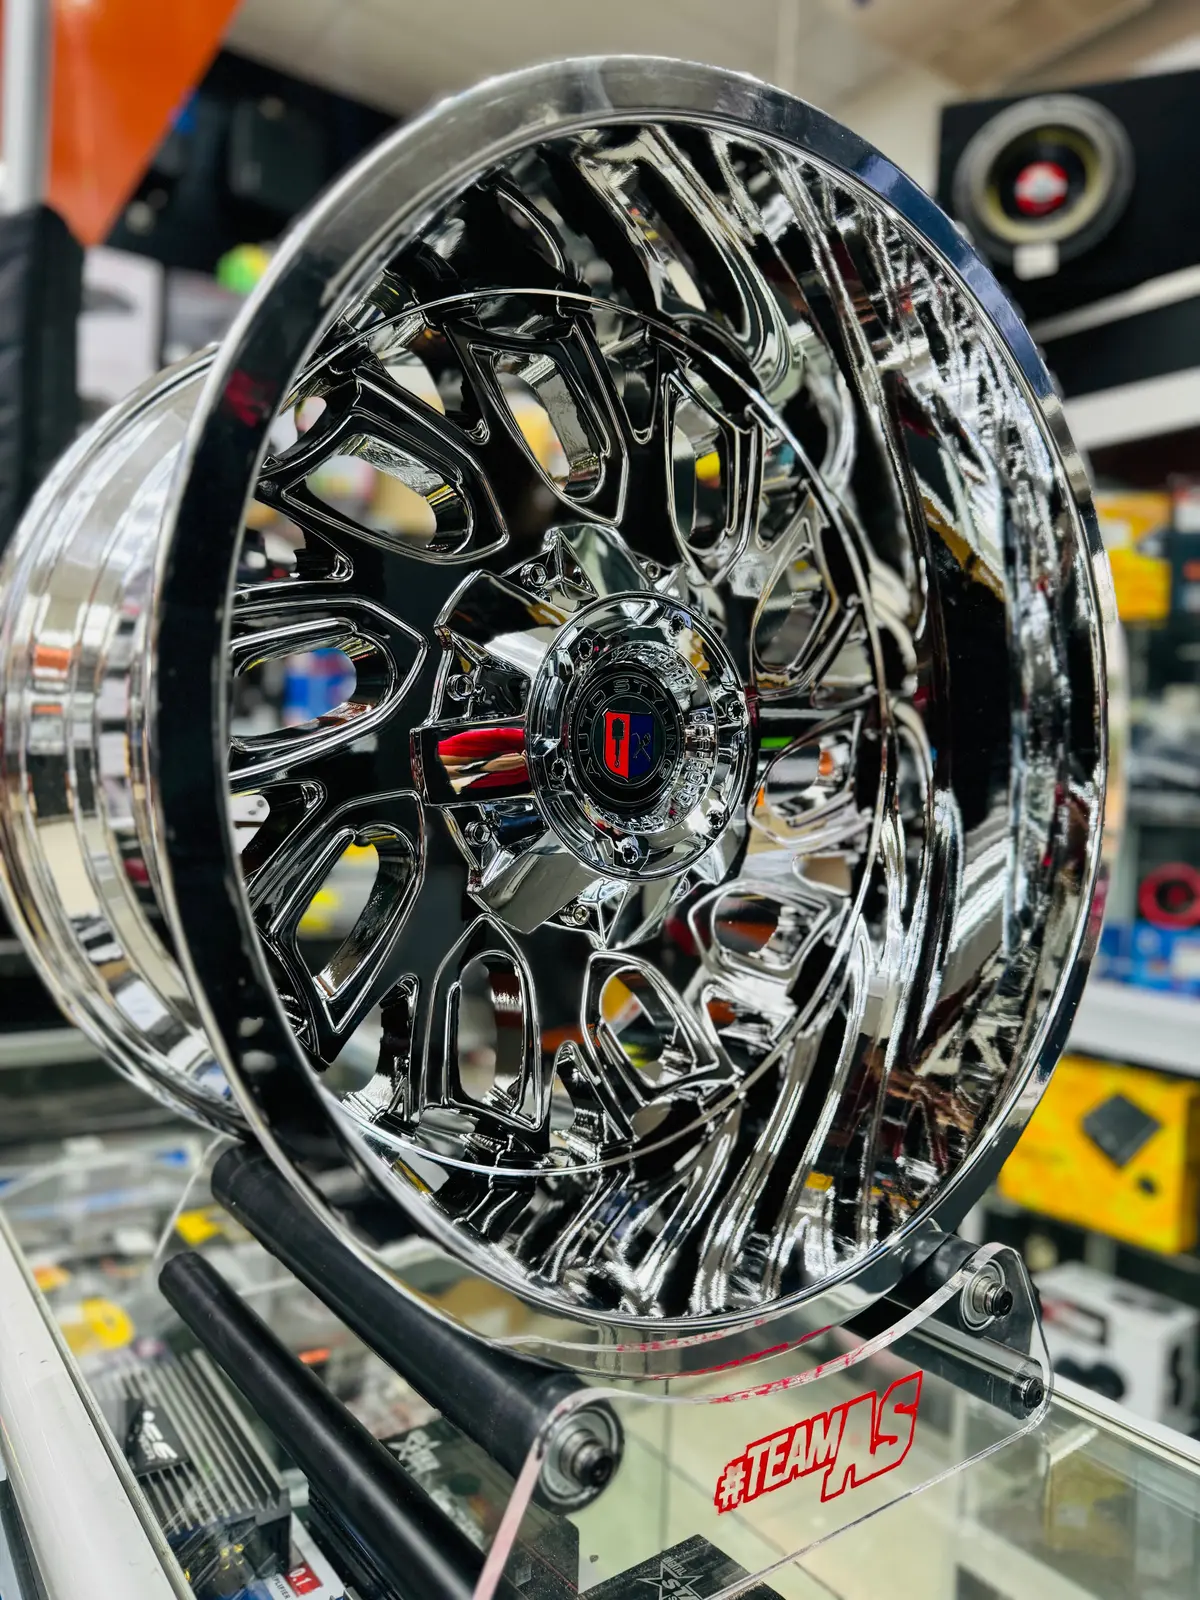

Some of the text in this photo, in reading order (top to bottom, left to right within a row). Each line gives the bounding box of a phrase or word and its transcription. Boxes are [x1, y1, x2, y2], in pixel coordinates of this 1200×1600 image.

[578, 678, 676, 780] AUTO STYLING
[662, 1556, 688, 1576] DIGITAL
